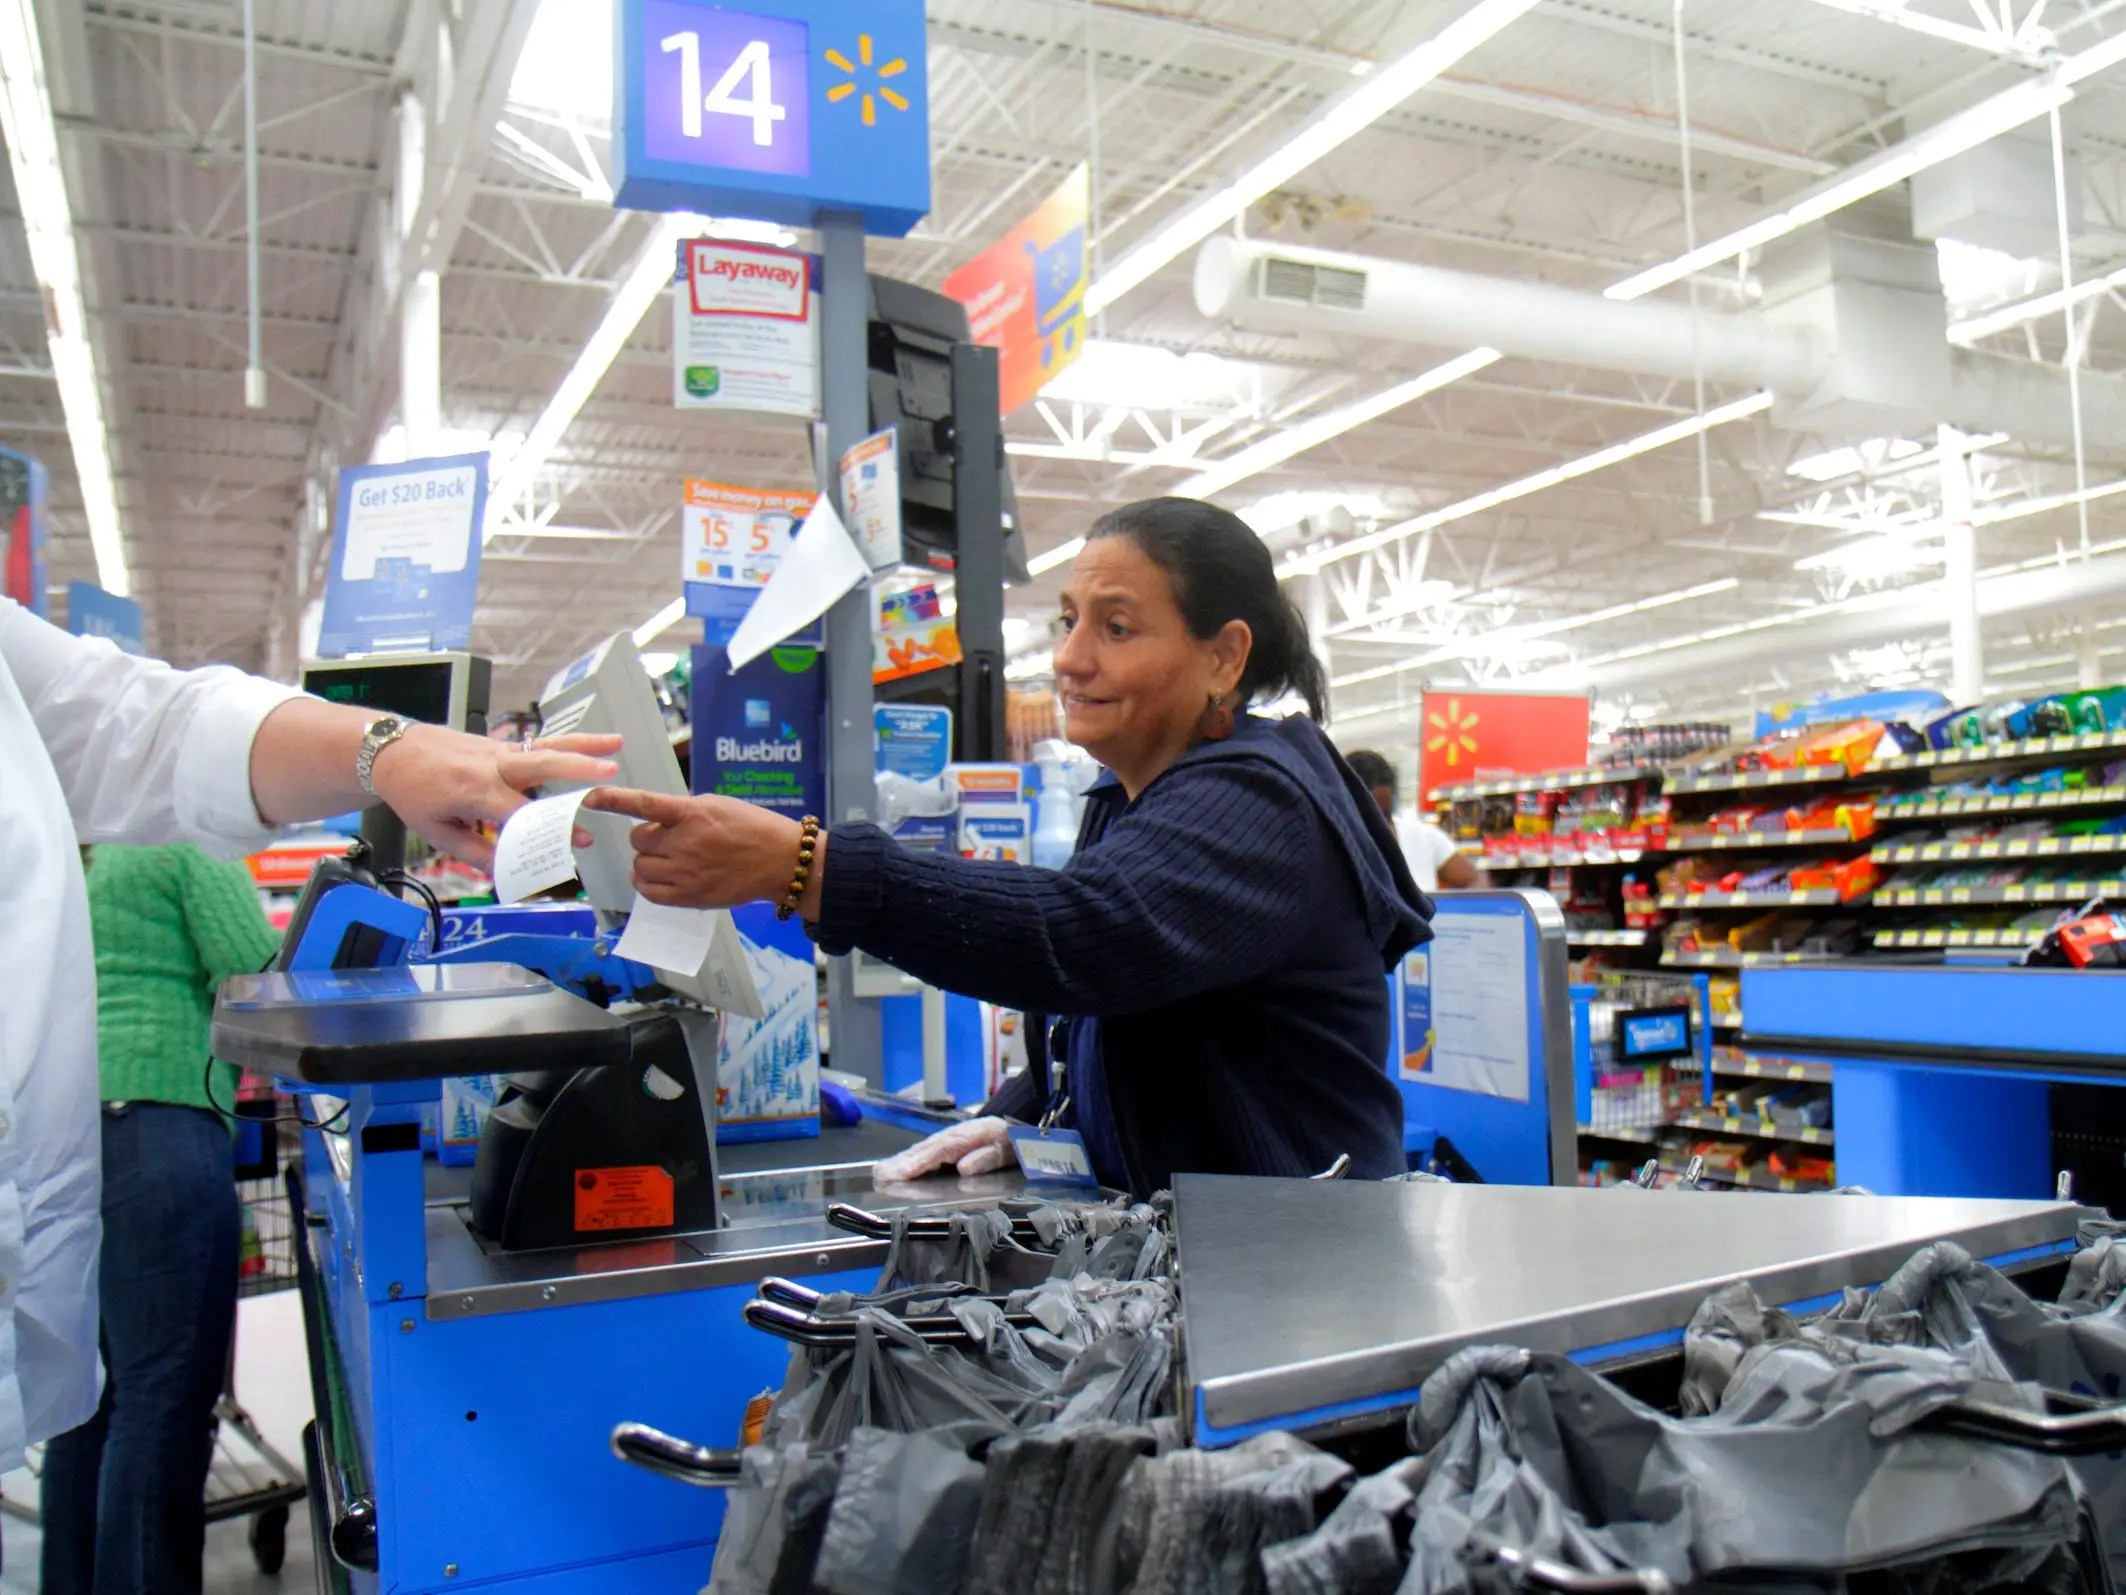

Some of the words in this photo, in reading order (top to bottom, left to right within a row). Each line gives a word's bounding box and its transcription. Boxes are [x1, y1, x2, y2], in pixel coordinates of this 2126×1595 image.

[660, 31, 786, 146] 14
[699, 254, 801, 289] Layaway
[359, 488, 387, 507] Get
[392, 484, 422, 505] $20
[426, 476, 465, 500] Back
[715, 736, 802, 763] Bluebird
[442, 916, 488, 941] 24
